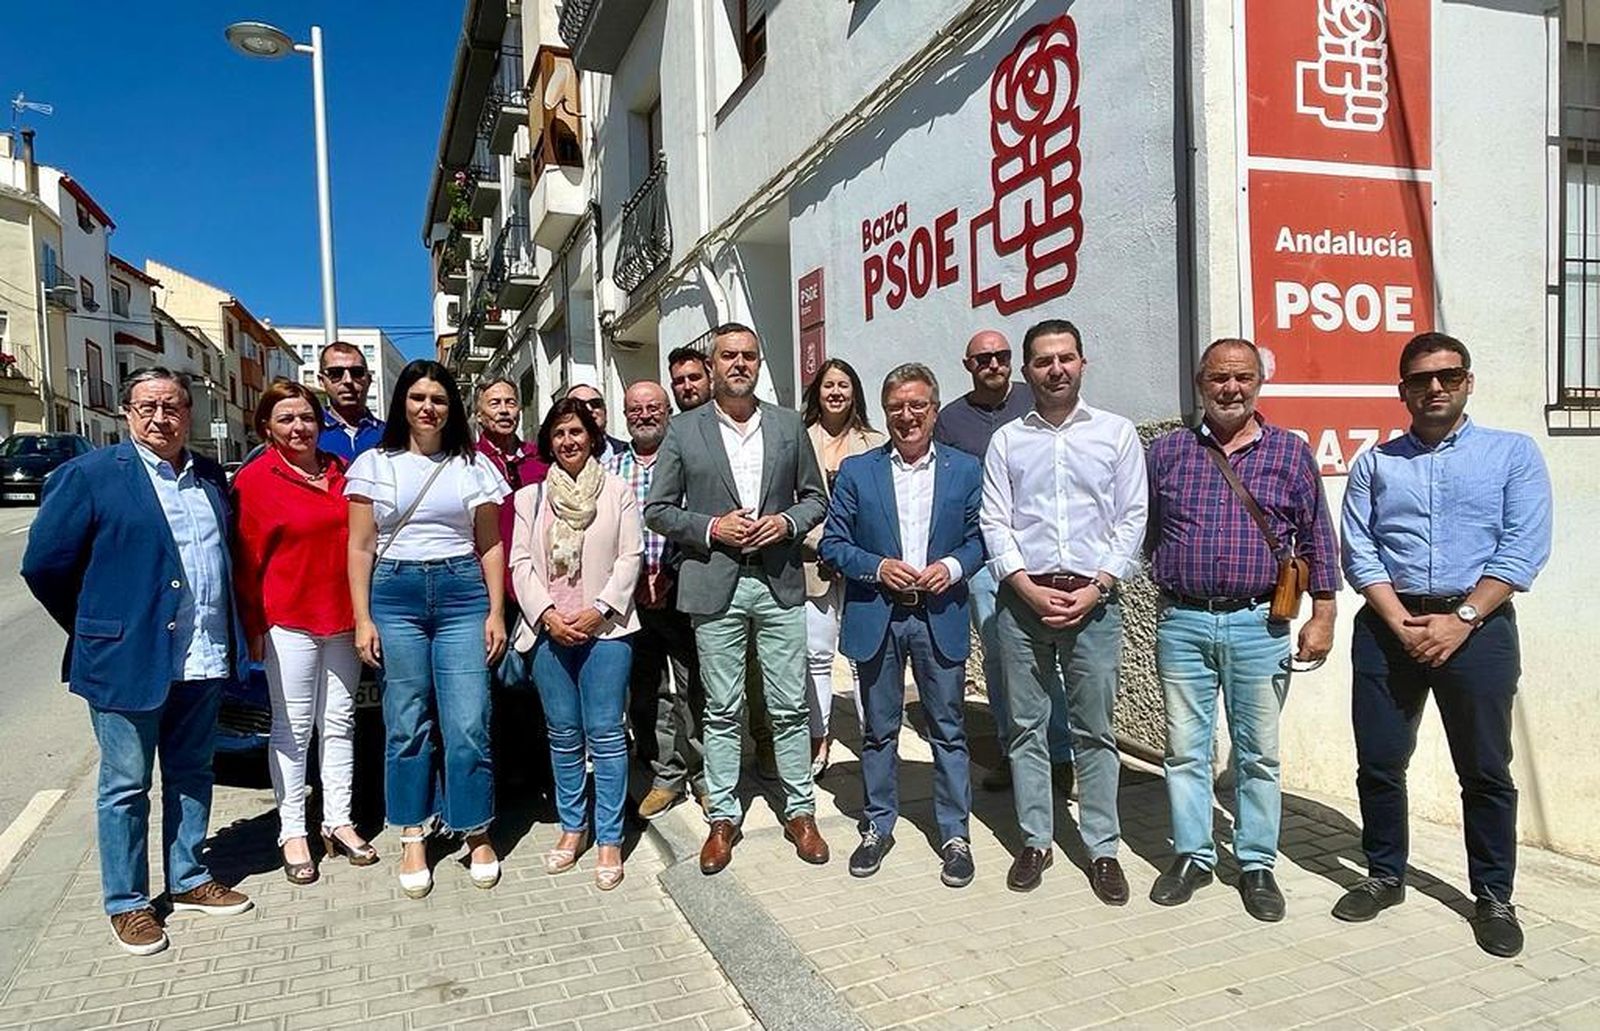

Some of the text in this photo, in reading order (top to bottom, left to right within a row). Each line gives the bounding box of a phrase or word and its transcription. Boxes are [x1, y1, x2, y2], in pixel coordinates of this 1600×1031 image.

[862, 201, 907, 253] Baza
[1275, 226, 1413, 258] Andalucía
[864, 207, 959, 322] PSOE
[1275, 281, 1415, 332] PSOE
[1288, 428, 1405, 474] AZ
